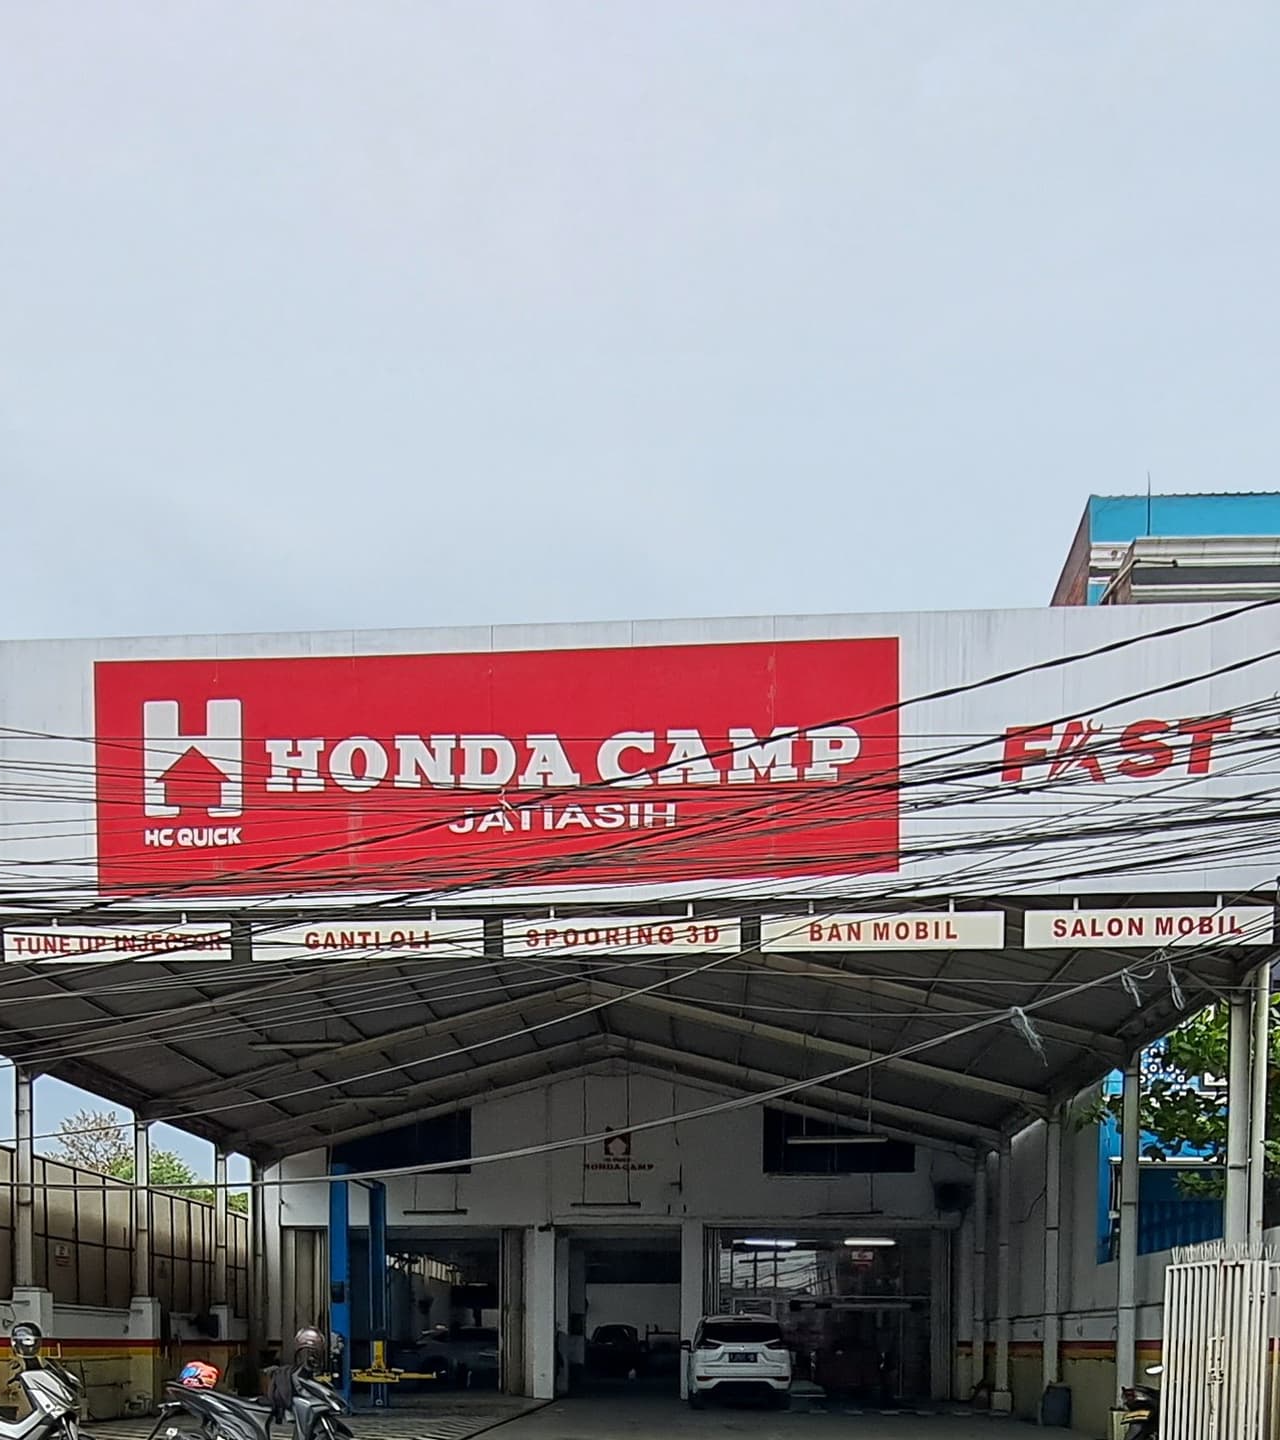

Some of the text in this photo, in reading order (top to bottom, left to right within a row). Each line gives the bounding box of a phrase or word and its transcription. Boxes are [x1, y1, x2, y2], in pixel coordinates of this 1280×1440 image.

[264, 725, 863, 794] HONDA CAMP
[1001, 716, 1233, 784] FAST
[447, 801, 676, 835] JATIASIH
[144, 827, 242, 847] HC QUICK
[526, 924, 719, 947] SPOORING 3D
[809, 920, 959, 942] BAN MOBIL
[1052, 915, 1244, 938] SALON MOBIL
[13, 935, 71, 955] TUNE
[79, 935, 107, 953] UP
[304, 929, 431, 950] GANTI OLI
